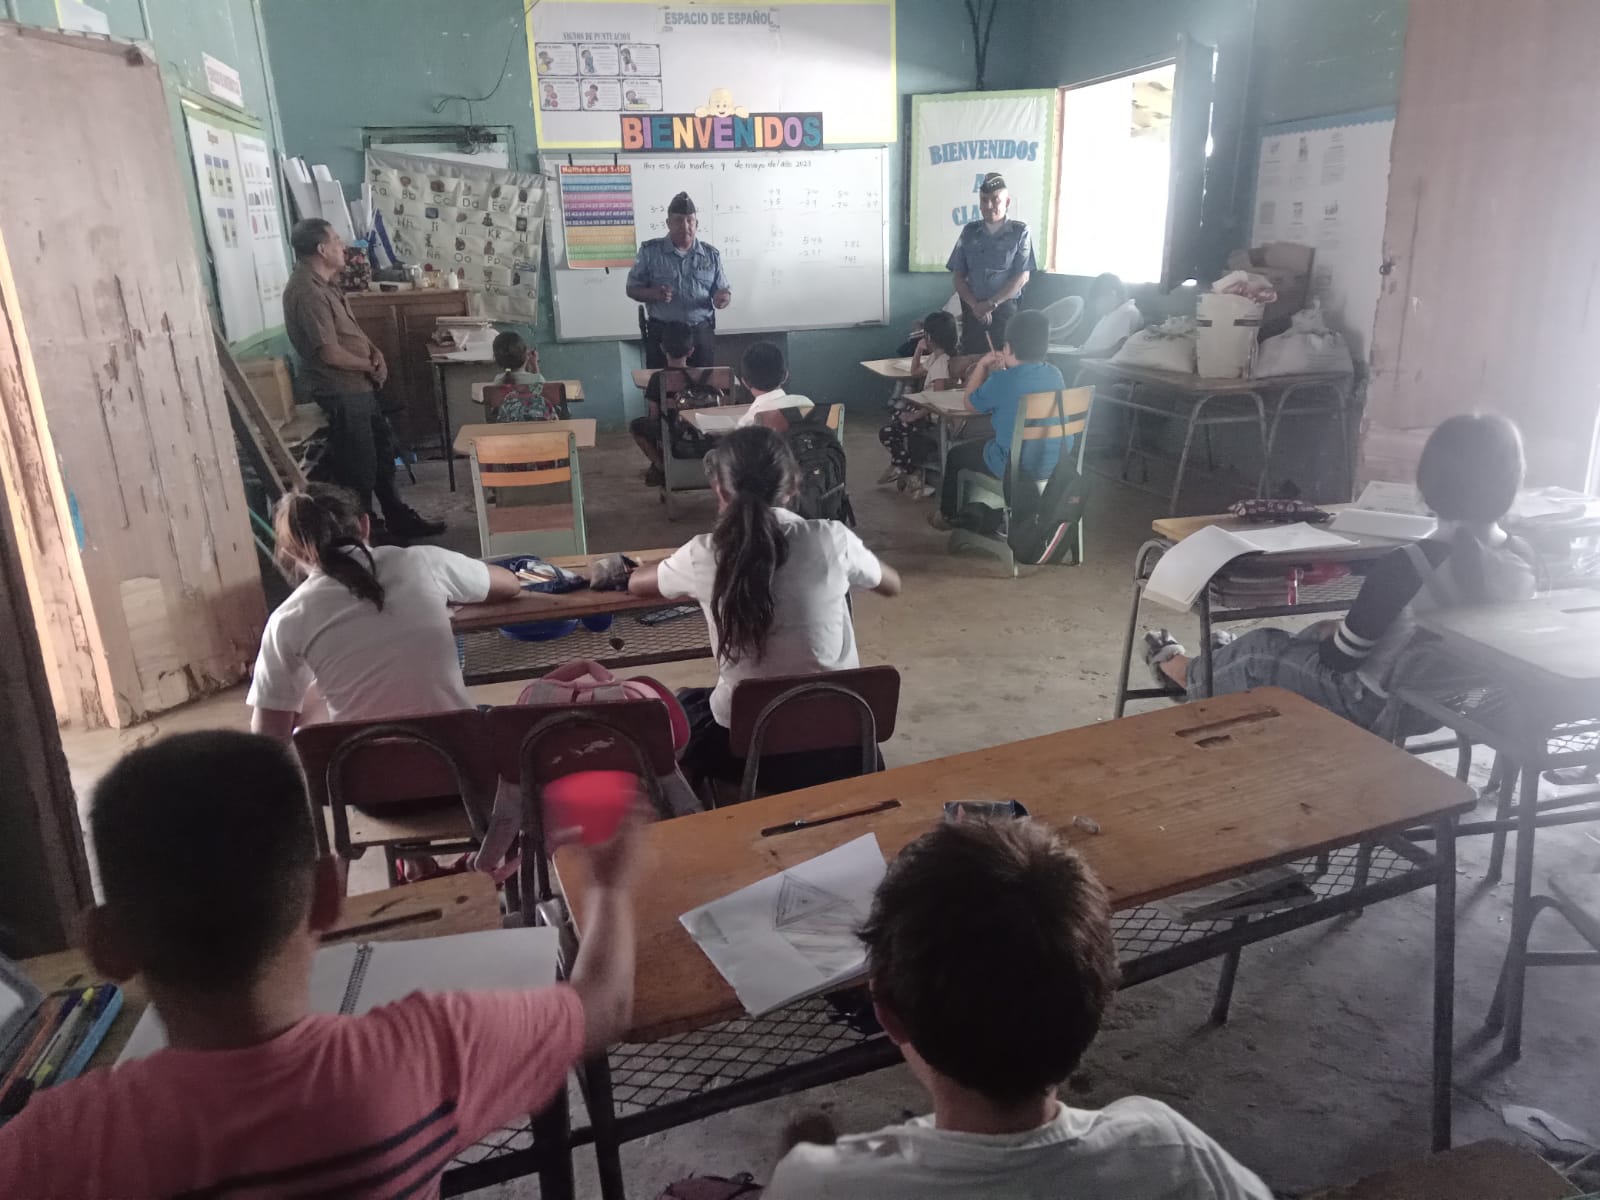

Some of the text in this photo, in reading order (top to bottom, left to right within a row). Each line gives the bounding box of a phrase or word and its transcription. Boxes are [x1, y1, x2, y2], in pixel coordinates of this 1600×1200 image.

[664, 9, 773, 25] ESPACIO DE ESPAÑOL
[622, 116, 820, 149] BIENVENIDOS
[928, 139, 1039, 165] BIENVENIDOS
[371, 184, 388, 197] Aa
[401, 189, 416, 201] Bb
[433, 194, 450, 206] Cc
[462, 198, 479, 209] Dd
[492, 200, 506, 212] Ee
[488, 228, 502, 239] Kk
[454, 252, 472, 263] Oo
[487, 257, 501, 265] Pp
